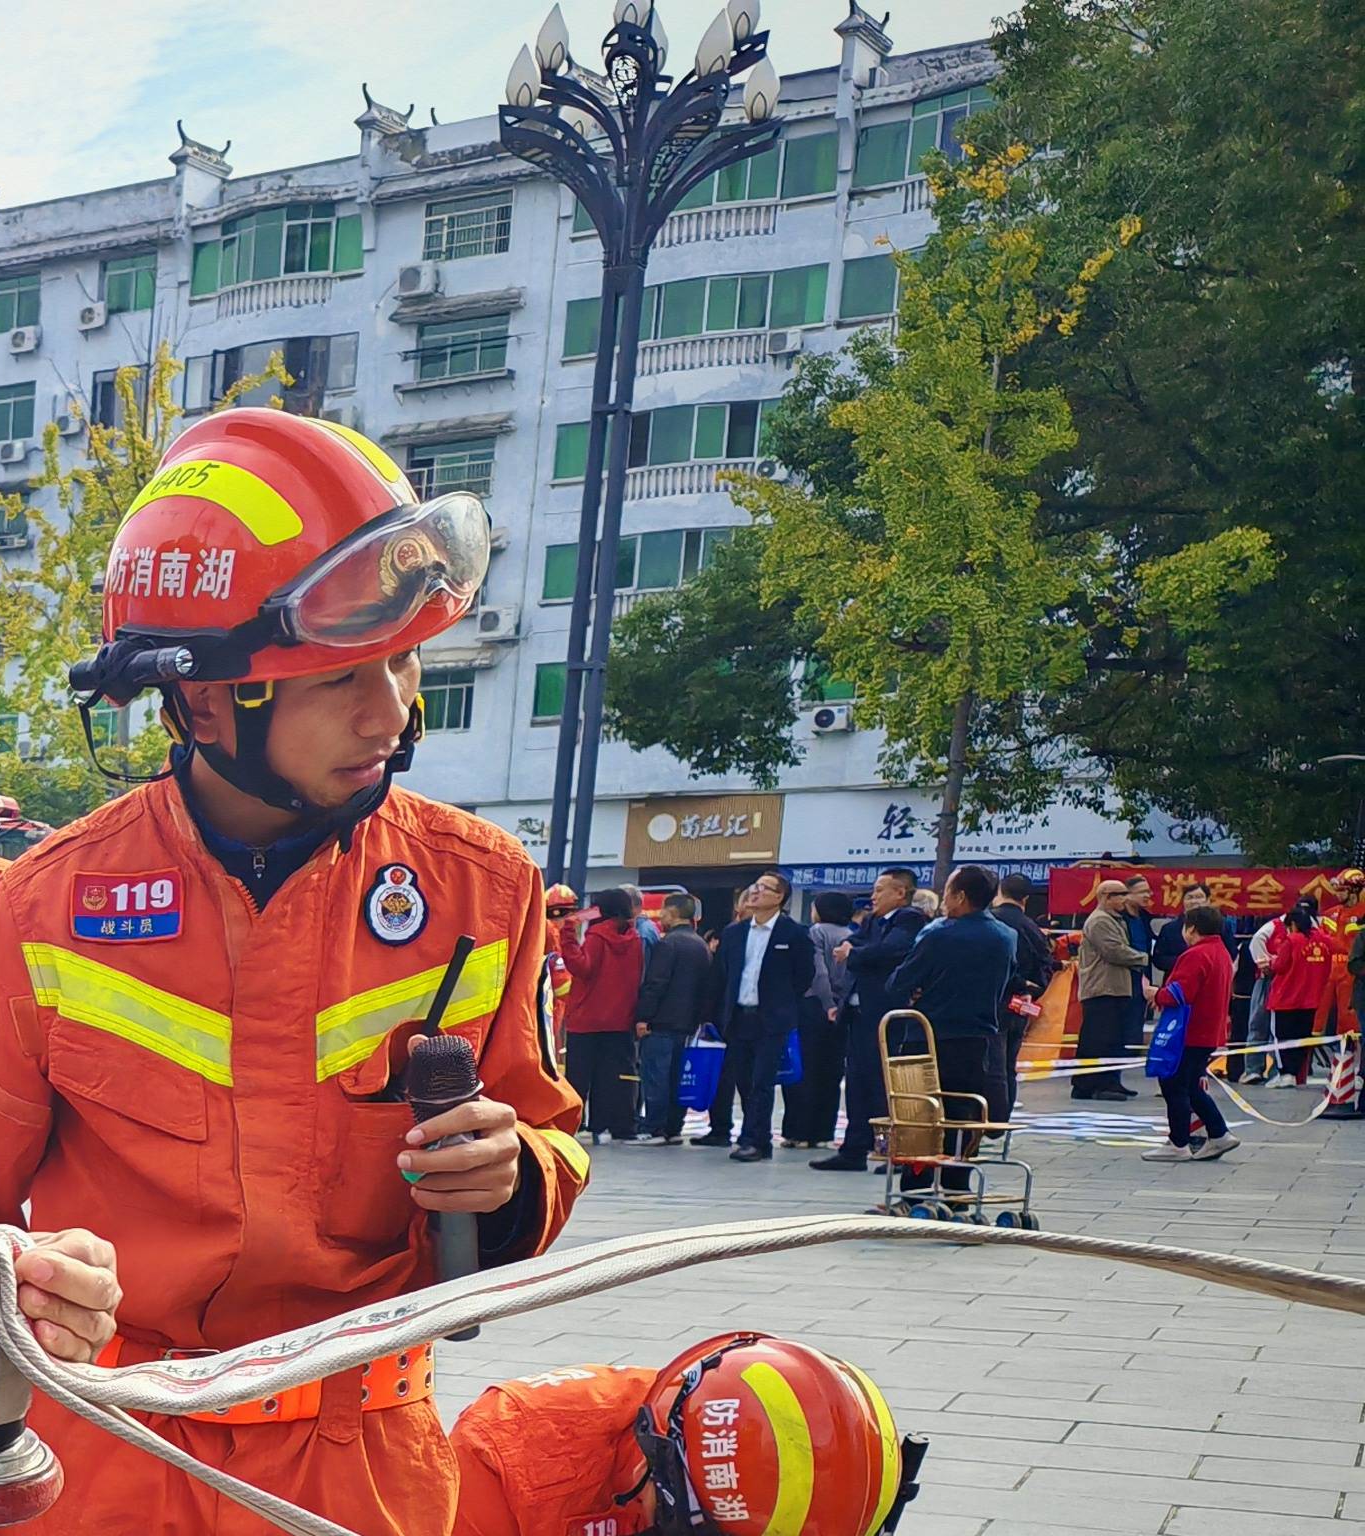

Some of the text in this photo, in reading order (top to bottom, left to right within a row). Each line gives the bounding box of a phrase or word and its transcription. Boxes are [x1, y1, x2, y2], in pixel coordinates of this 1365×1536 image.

[110, 879, 174, 911] 119
[101, 918, 153, 935] 战斗员
